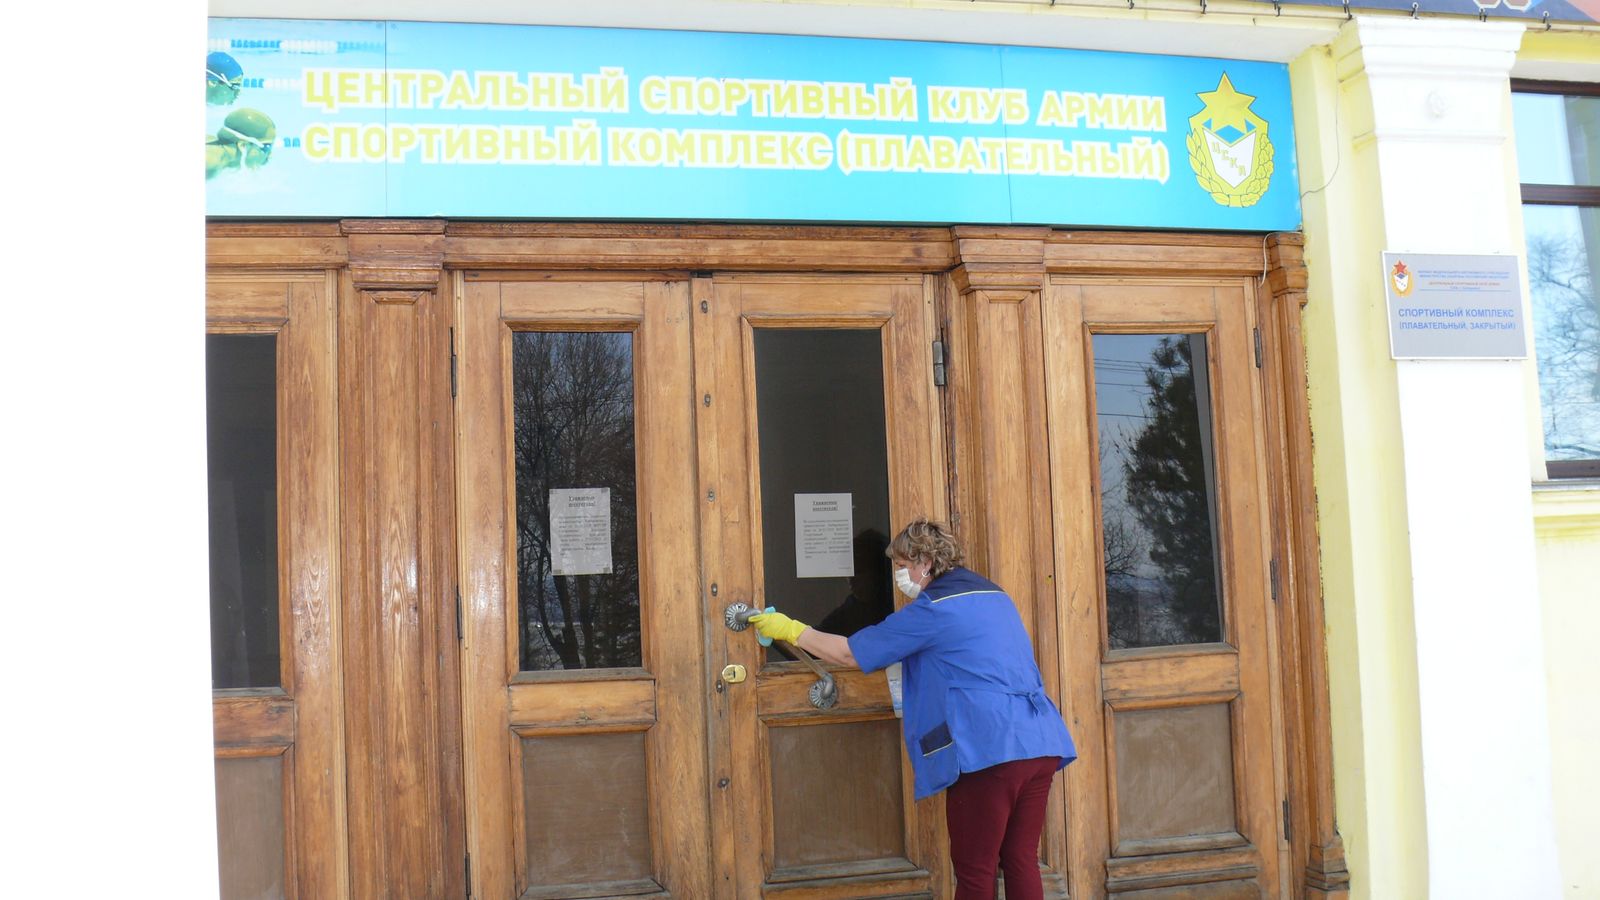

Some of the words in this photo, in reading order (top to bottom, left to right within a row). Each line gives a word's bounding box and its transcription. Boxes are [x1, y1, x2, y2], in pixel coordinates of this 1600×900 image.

[304, 69, 627, 111] ЦЕНТРАЛЬНЫЙ
[642, 78, 916, 119] СПОРТИВНЫЙ
[930, 88, 1028, 121] КЛУБ
[1040, 93, 1164, 130] АРМИИ
[304, 122, 599, 163] СПОРТИВНЫЙ
[610, 129, 831, 168] КОМПЛЕКС
[838, 131, 1168, 181] (ПЛАВАТЕЛЬНЫЙ)
[1398, 306, 1463, 318] СПОРТИВНЫЙ
[1465, 308, 1515, 318] КОМПЛЕКС
